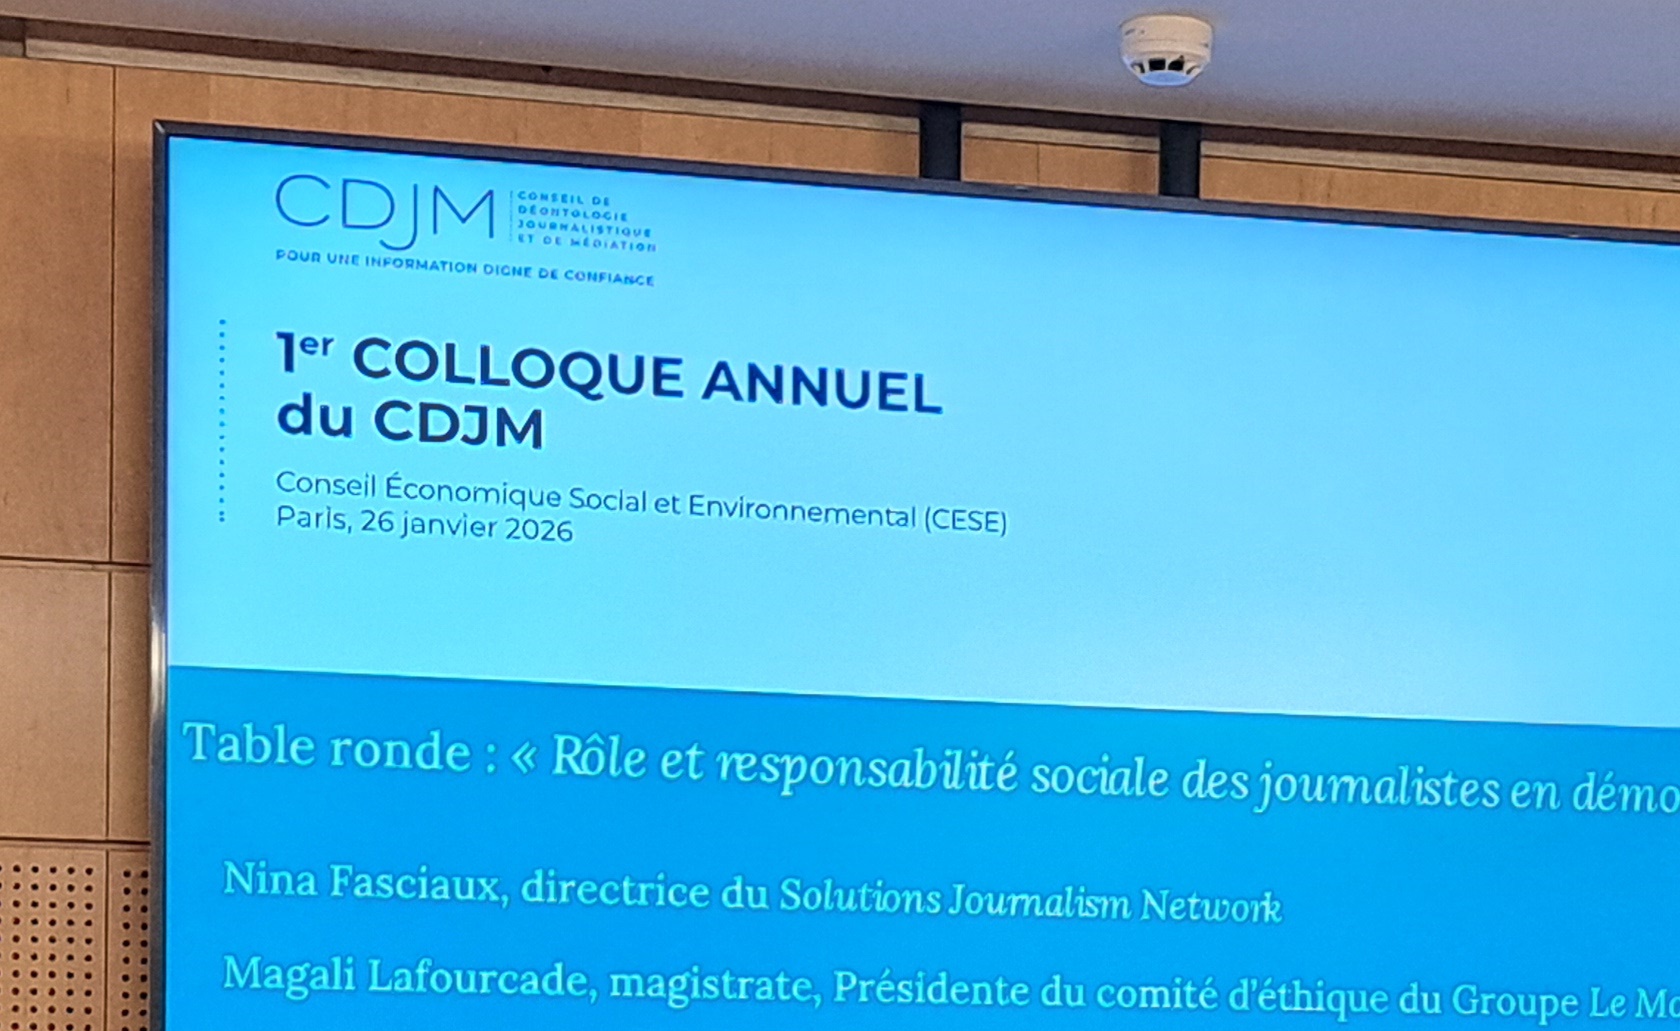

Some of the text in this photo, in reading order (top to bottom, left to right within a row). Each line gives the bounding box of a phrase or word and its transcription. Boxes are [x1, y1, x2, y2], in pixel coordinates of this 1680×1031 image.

[276, 174, 494, 251] CDJM
[517, 191, 610, 206] CONSEIL DE
[517, 219, 652, 237] JOURNALISTIQUE
[276, 249, 654, 287] POUR UNE INFORMATION DIGNE DE CONFIANCE
[518, 233, 534, 244] ET
[543, 236, 561, 246] DE
[275, 331, 944, 415] 1er COLLOQUE ANNUEL
[276, 392, 543, 450] du CDJM
[275, 470, 1010, 537] Conseil Économique Social et Environnemental (CESE)
[276, 506, 575, 545] Paris, 26 janvier 2026
[183, 721, 316, 769] Table
[330, 731, 471, 773] ronde
[486, 743, 498, 773] :
[510, 745, 538, 771] «
[551, 733, 648, 778] Rôle
[659, 743, 704, 780] et
[716, 748, 1017, 795] responsabilité
[1030, 752, 1169, 798] sociale
[1181, 759, 1250, 801] des
[1255, 762, 1501, 814] journalistes
[1509, 778, 1561, 811] en
[222, 860, 1284, 926] Nina Fasciaux, directrice du Solutions Journalism Network
[222, 956, 355, 1001] Magali
[368, 958, 599, 1005] Lafourcade,
[609, 967, 824, 1011] magistrate,
[832, 971, 1030, 1008] Présidente
[1039, 974, 1086, 1009] du
[1096, 977, 1217, 1012] comité
[1399, 982, 1442, 1016] du
[1451, 984, 1579, 1026] Groupe
[1589, 988, 1627, 1020] Le
